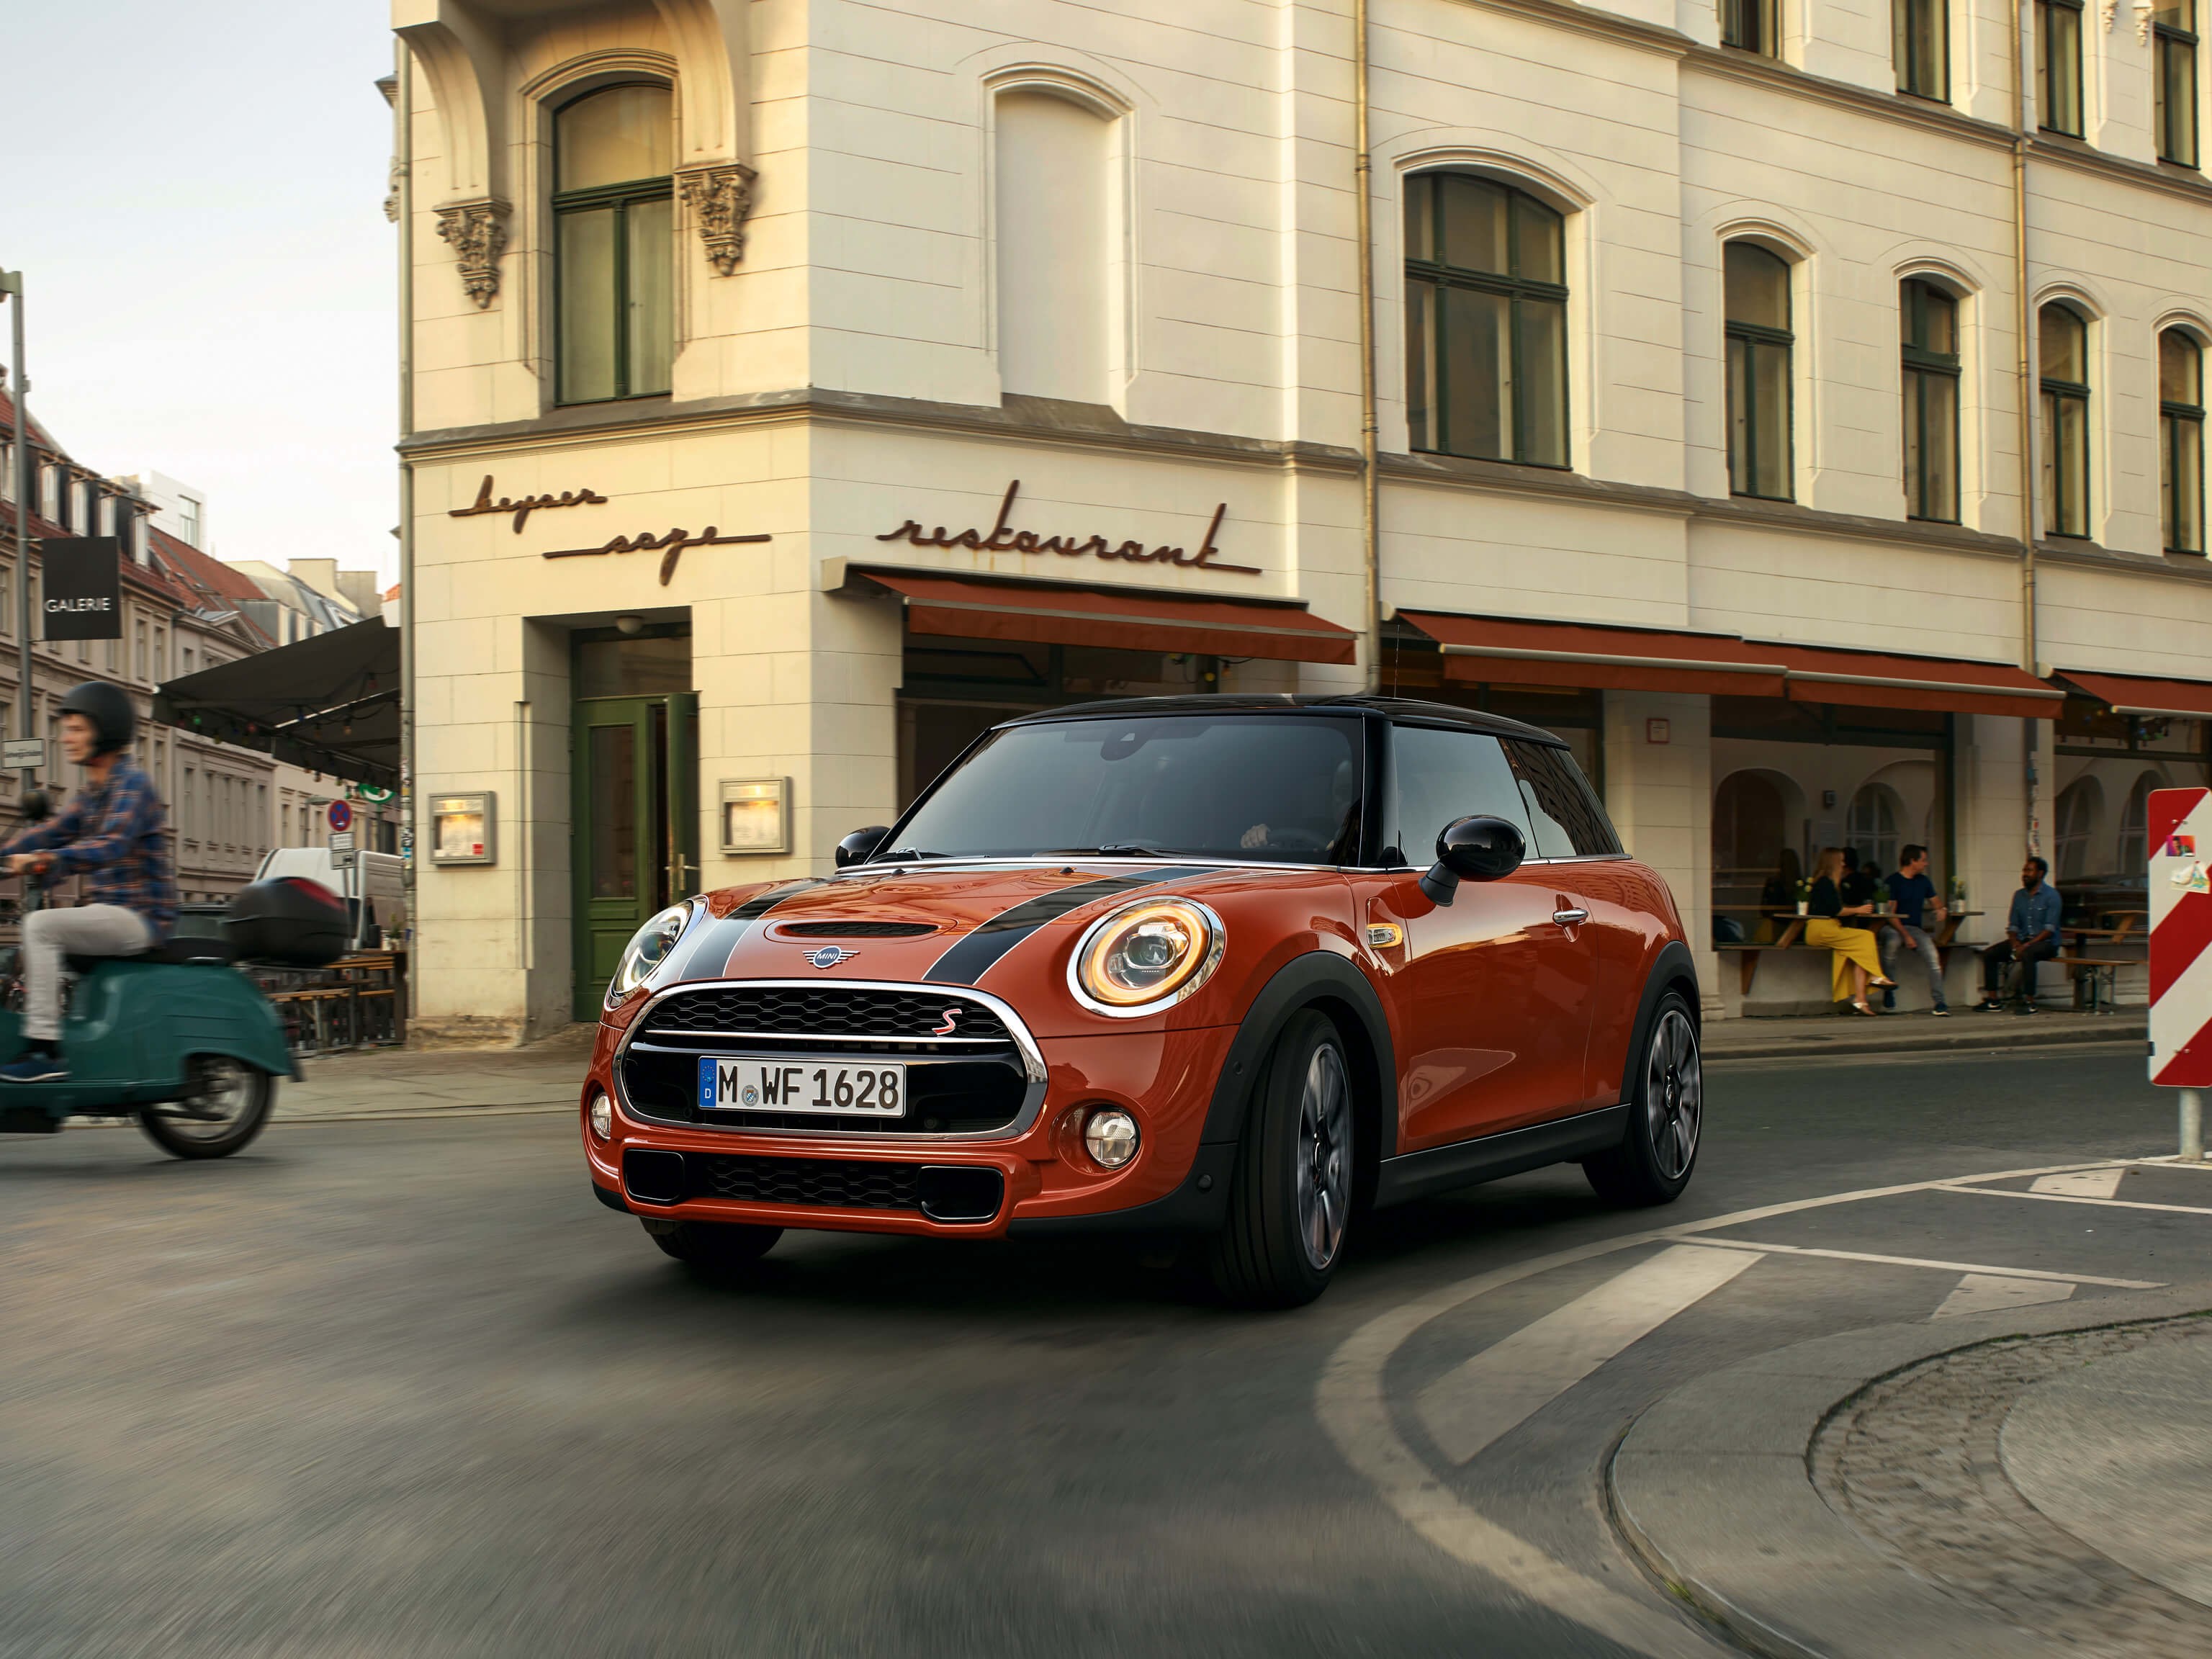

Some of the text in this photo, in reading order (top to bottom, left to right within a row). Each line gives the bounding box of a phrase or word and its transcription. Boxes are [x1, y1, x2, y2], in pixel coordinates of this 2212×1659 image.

[875, 480, 1263, 575] restaurant
[45, 598, 111, 612] GALERIE
[932, 1008, 963, 1035] S
[704, 1088, 711, 1099] D
[812, 1069, 899, 1110] 1628
